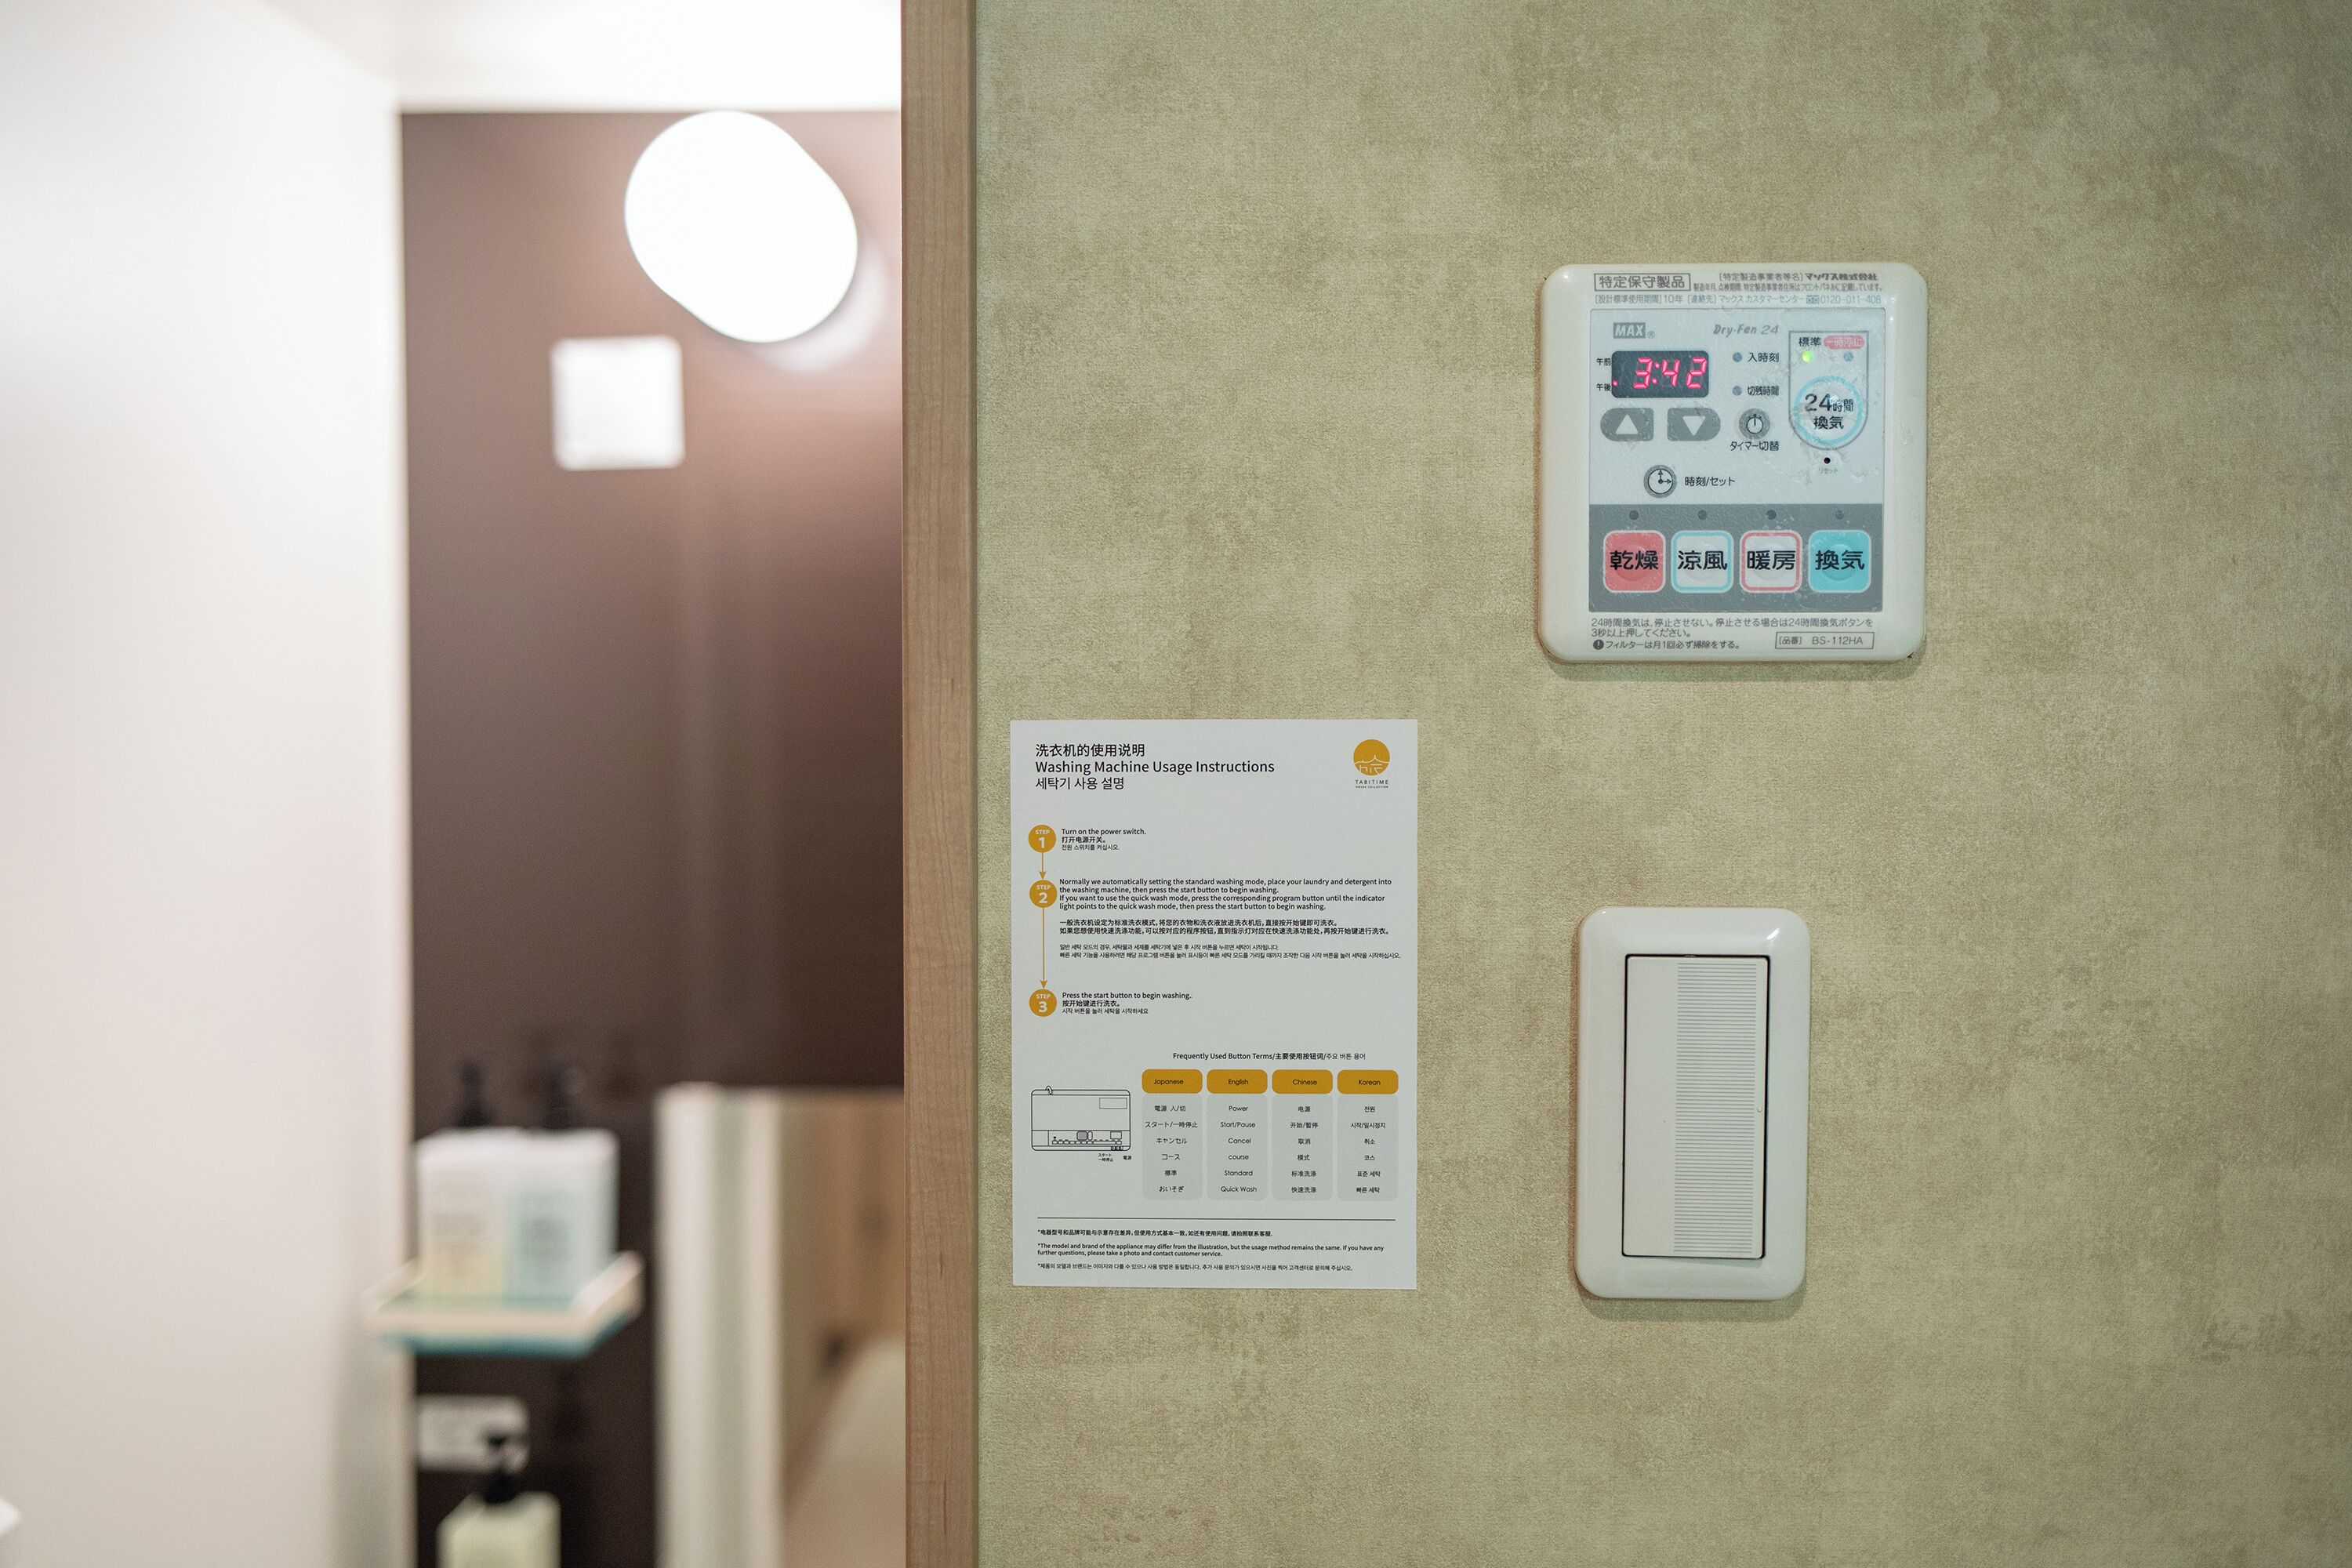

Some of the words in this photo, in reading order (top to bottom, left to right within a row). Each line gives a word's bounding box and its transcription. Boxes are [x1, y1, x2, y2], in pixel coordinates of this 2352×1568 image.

[1599, 276, 1685, 289] 特定保守製品
[1664, 295, 1683, 303] 10年
[1748, 295, 1804, 303] カスタマーセンター
[1820, 295, 1882, 304] 0120-011-408
[1614, 323, 1646, 338] MAX
[1761, 325, 1779, 334] 24
[1798, 337, 1821, 347] 標準
[1748, 353, 1779, 362] 入時刻
[1633, 357, 1708, 390] 3:42
[1748, 386, 1779, 396] 切残時間
[1805, 393, 1853, 412] 24時間
[1813, 416, 1844, 430] 換気
[1730, 441, 1780, 452] タイマー切替
[1685, 477, 1735, 487] 時刻/セット
[1610, 550, 1659, 570] 乾燥
[1677, 550, 1728, 570] 涼風
[1747, 550, 1796, 570] 暖房
[1815, 550, 1865, 570] 換気
[1592, 628, 1691, 638] 3秒以上押してください。
[1812, 637, 1864, 646] BS-112HA
[1036, 742, 1145, 758] 洗衣机的使用说明
[1036, 760, 1092, 775] Washing
[1094, 760, 1149, 772] Machine
[1153, 761, 1192, 775] Usage
[1196, 760, 1274, 772] Instructions
[1036, 776, 1070, 790] 세탁기
[1073, 776, 1098, 790] 사용
[1099, 776, 1123, 789] 설명
[1039, 837, 1045, 848] 1
[1039, 891, 1047, 903] 2
[1142, 991, 1160, 1000] begin
[1161, 991, 1192, 1000] washing..
[1038, 1001, 1047, 1013] 3
[1173, 1051, 1209, 1062] Frequently
[1252, 1051, 1338, 1061] Terms/主要使用按钮词/주요
[1340, 1051, 1352, 1060] 버튼
[1353, 1051, 1366, 1060] 용어
